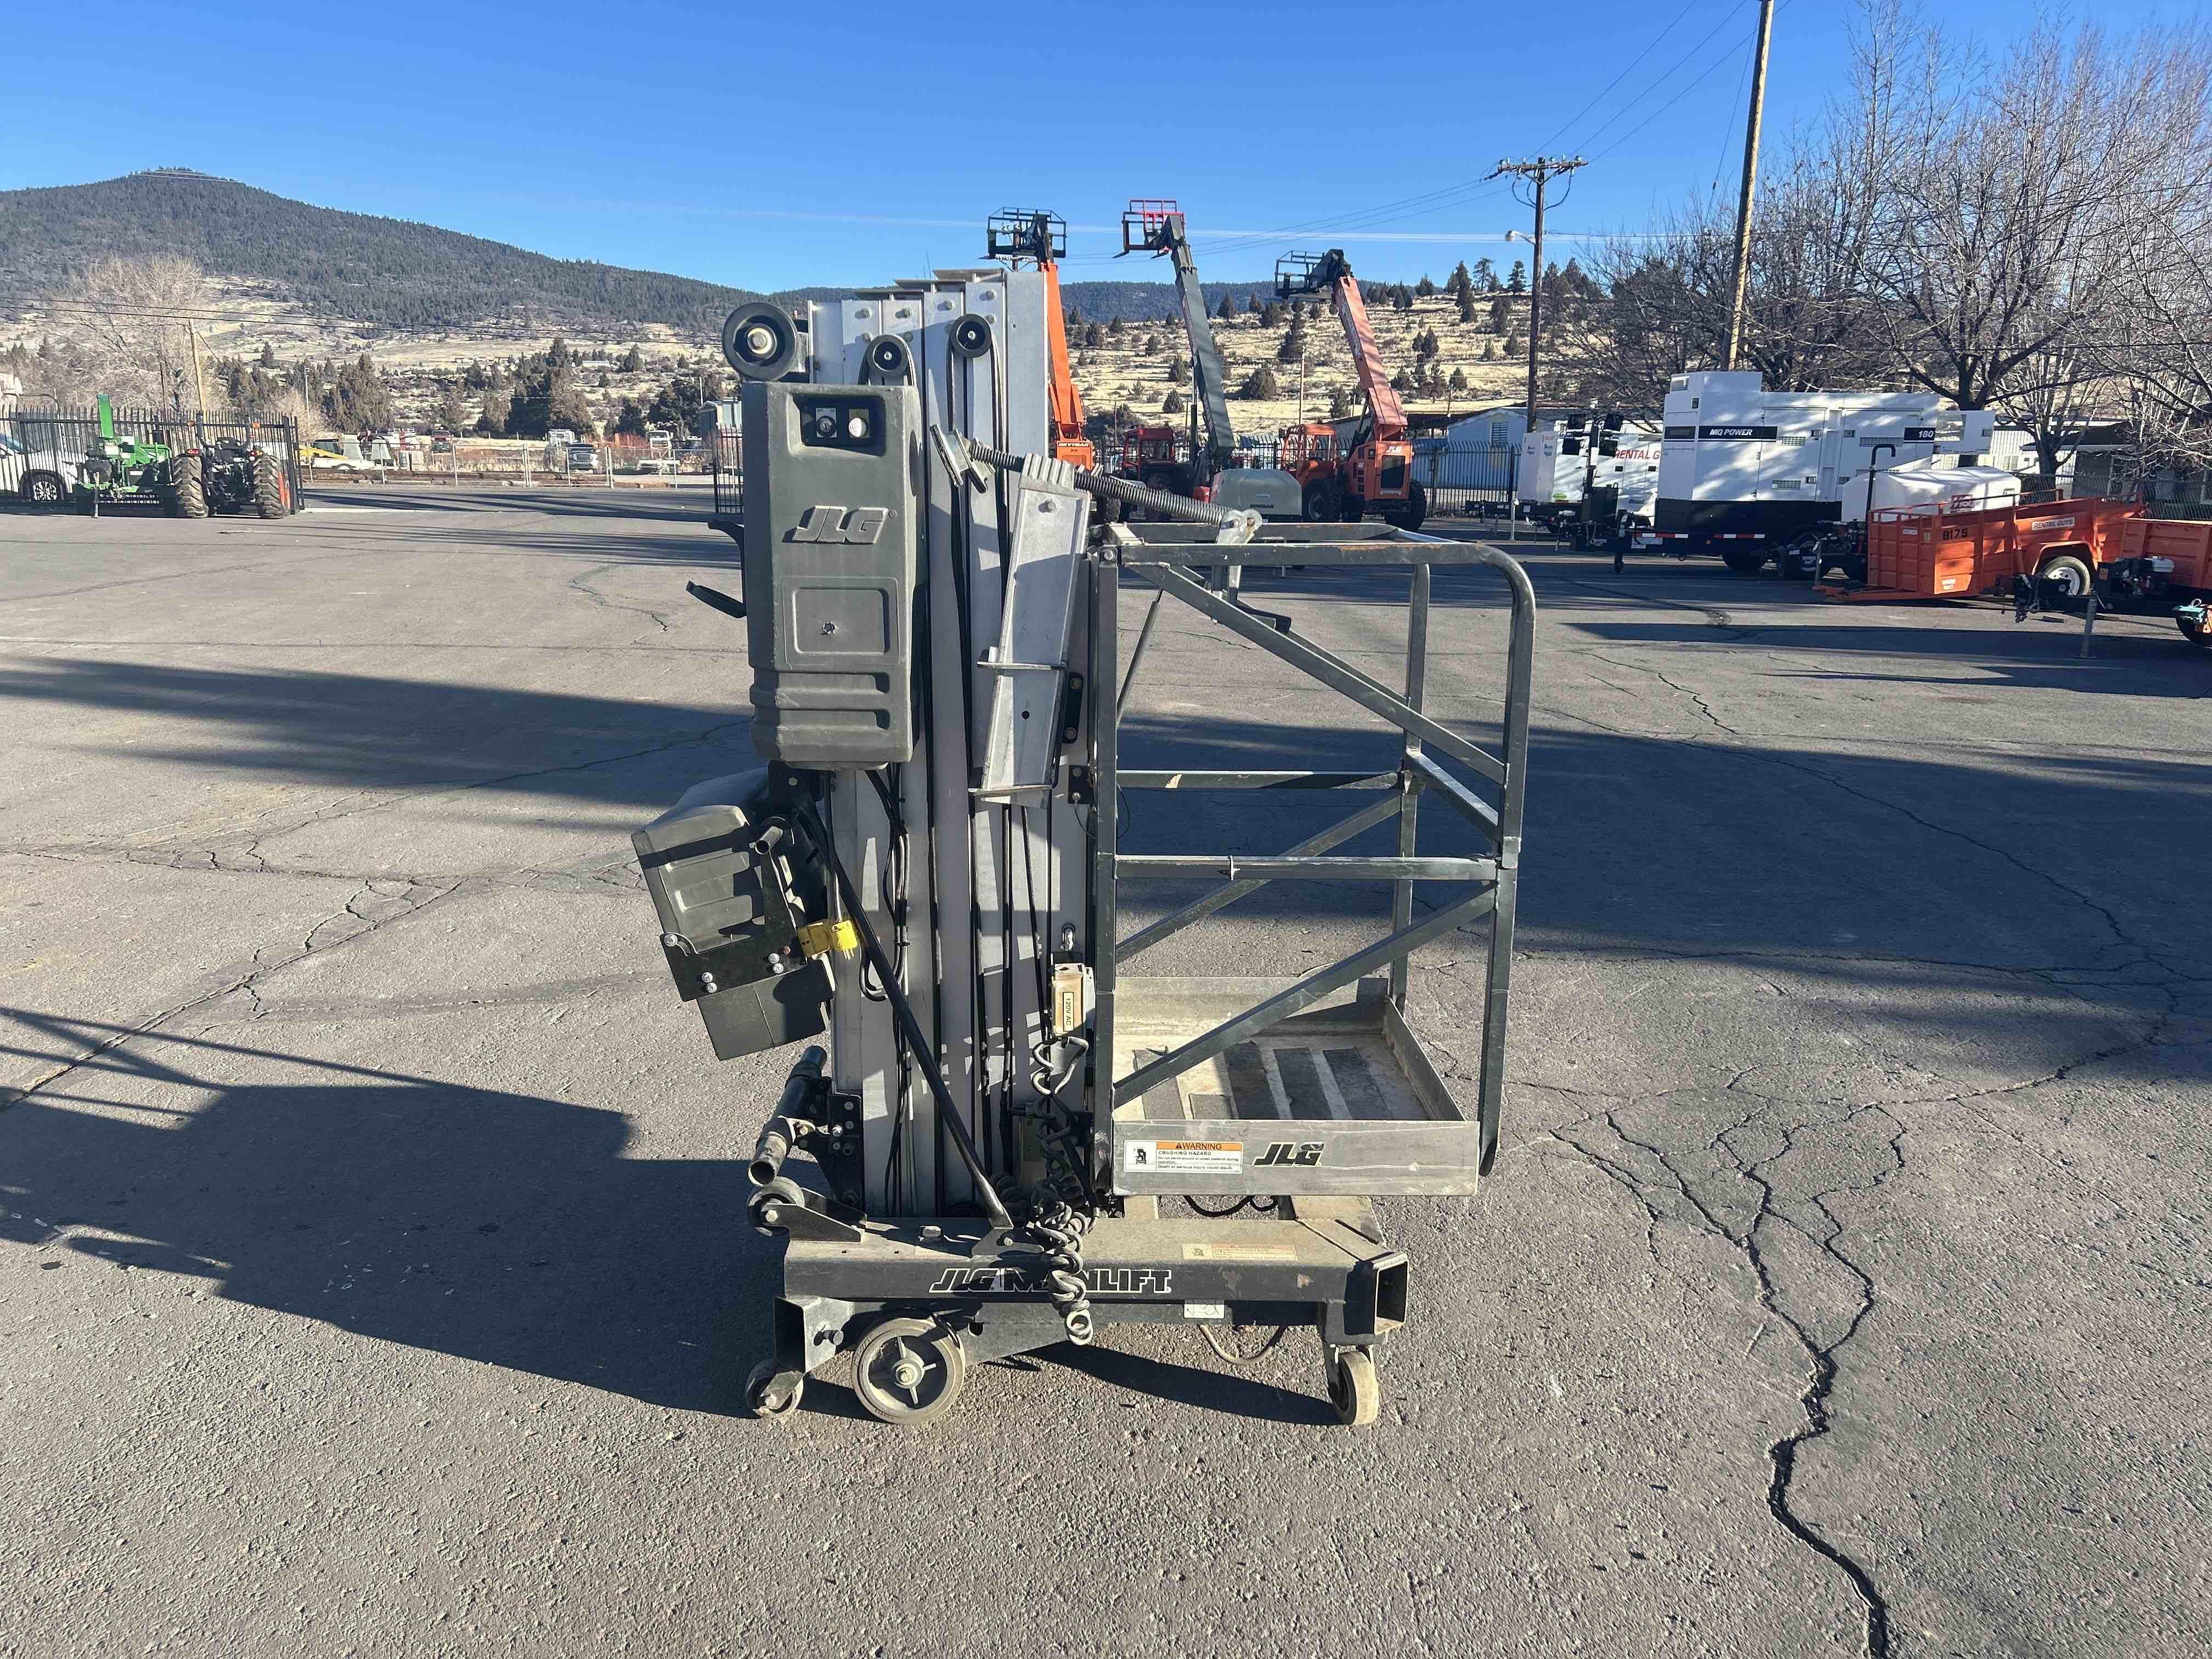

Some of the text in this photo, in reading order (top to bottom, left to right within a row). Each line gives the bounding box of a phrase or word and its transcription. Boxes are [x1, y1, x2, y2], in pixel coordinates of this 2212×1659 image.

[1615, 449, 1650, 460] RENTAL
[789, 505, 889, 544] JLG
[1066, 1016, 1071, 1026] AC
[1251, 1142, 1324, 1167] JLG
[929, 1268, 1001, 1293] JLG
